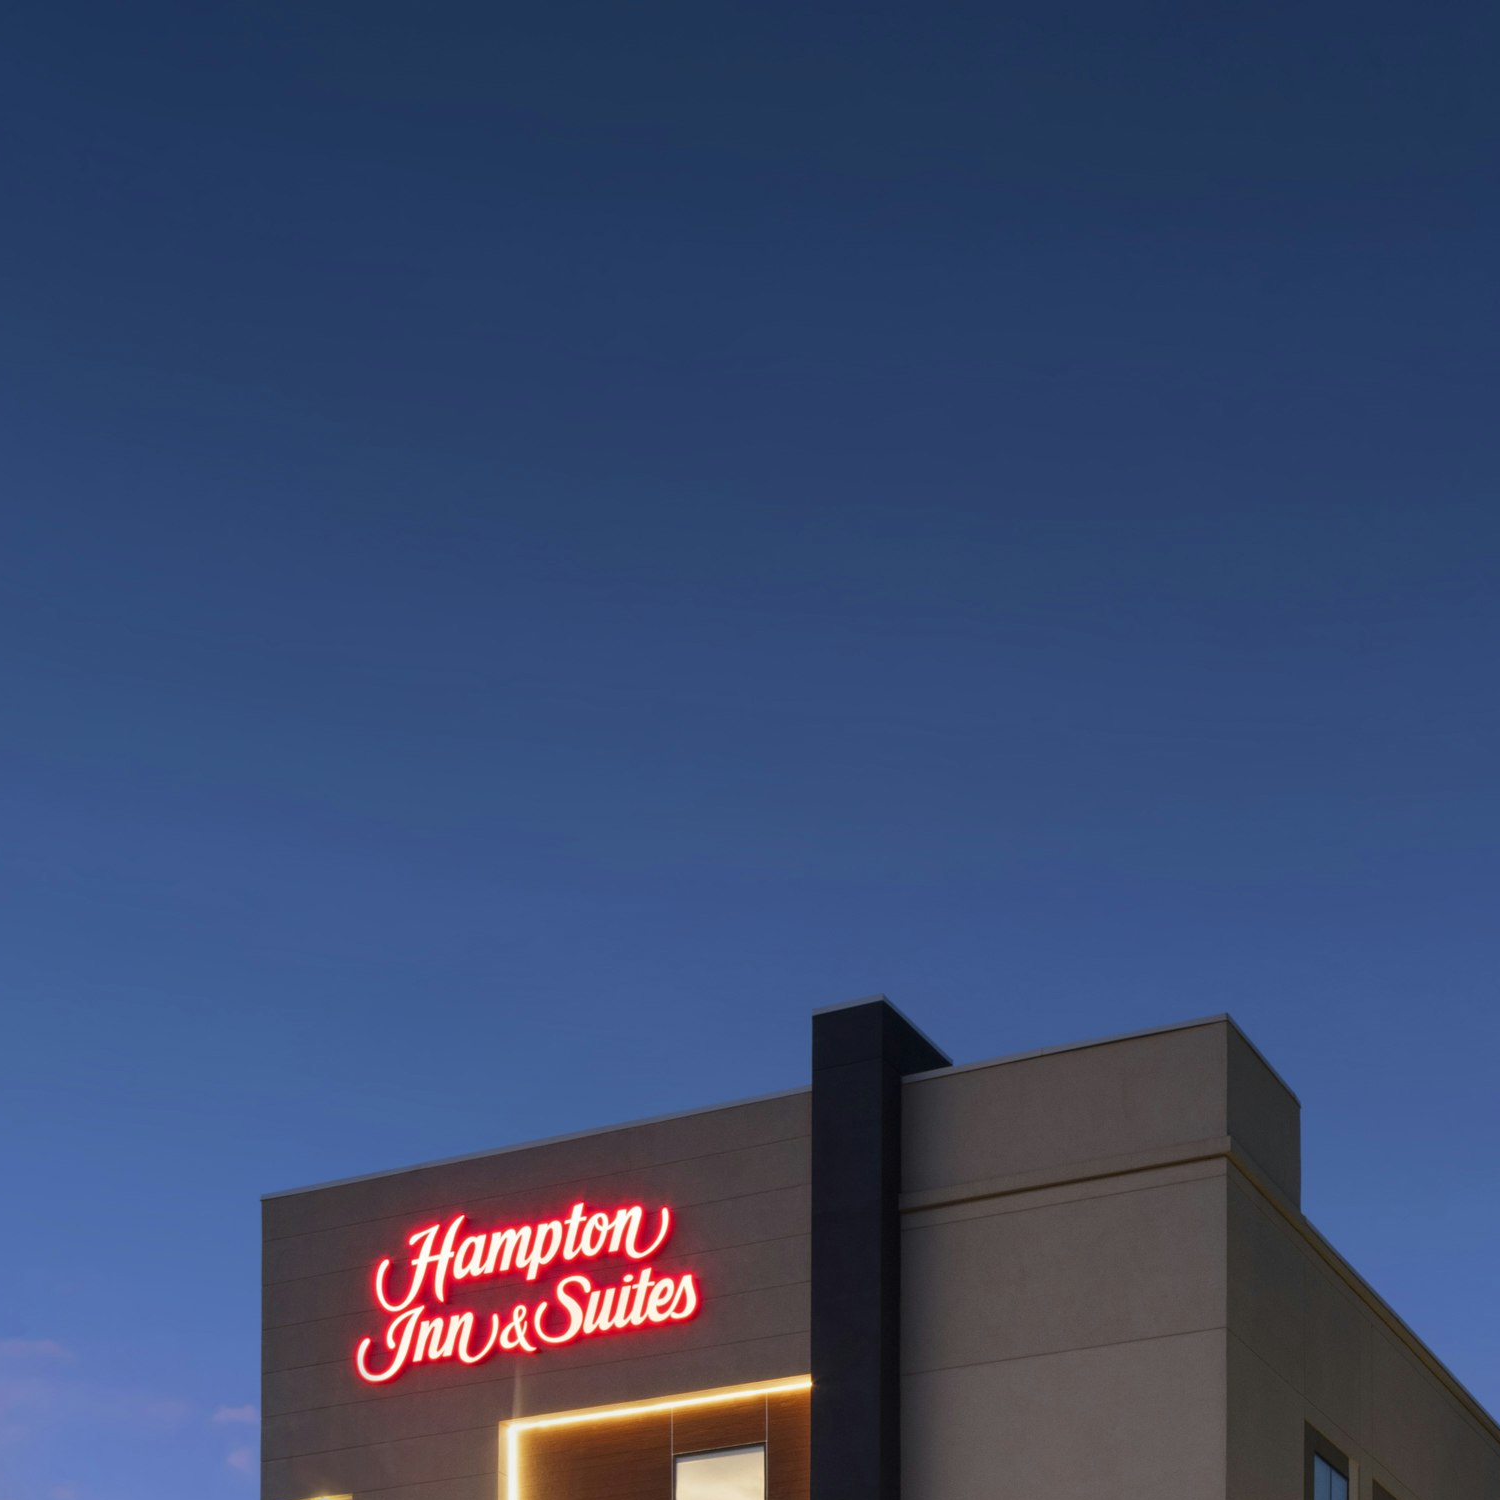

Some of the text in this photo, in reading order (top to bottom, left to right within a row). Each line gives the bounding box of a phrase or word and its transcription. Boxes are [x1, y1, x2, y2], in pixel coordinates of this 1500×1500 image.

[375, 1202, 670, 1312] Hampton
[356, 1267, 697, 1382] Inn & Suites
